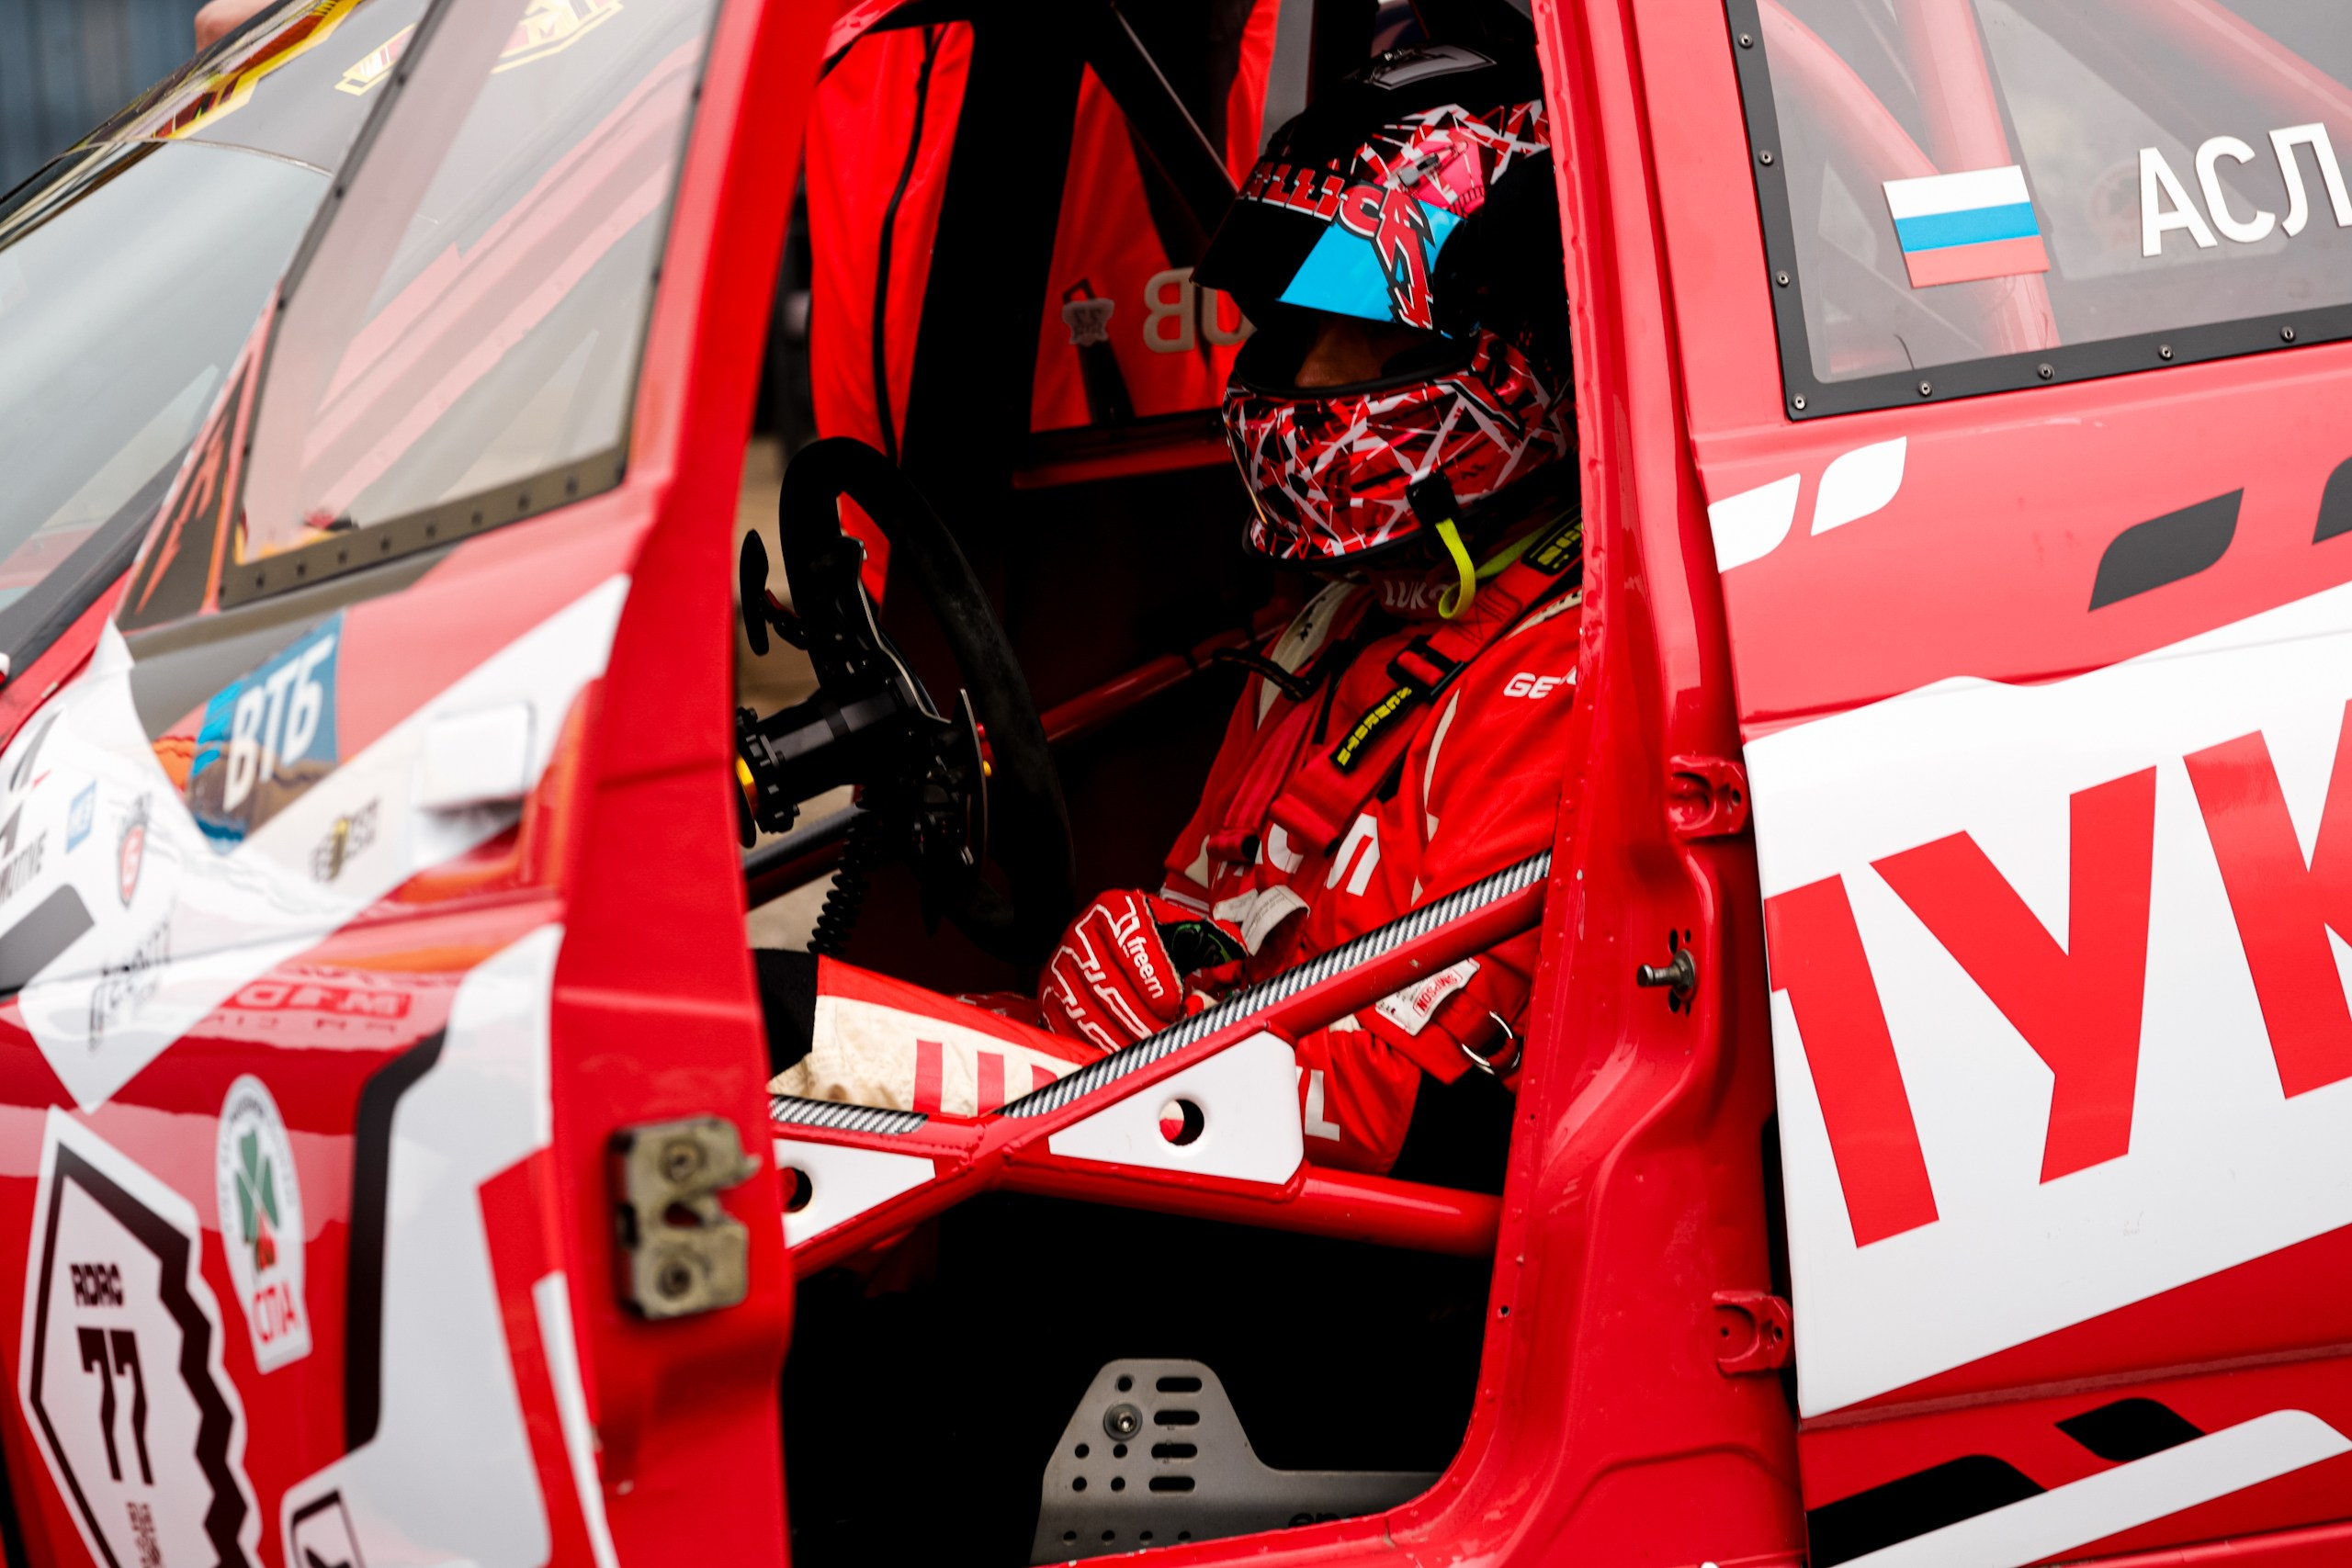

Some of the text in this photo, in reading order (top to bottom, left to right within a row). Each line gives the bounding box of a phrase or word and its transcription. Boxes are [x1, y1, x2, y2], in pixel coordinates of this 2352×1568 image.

[222, 633, 336, 813] ВТБ
[1126, 935, 1165, 999] freem
[76, 1325, 154, 1486] 77
